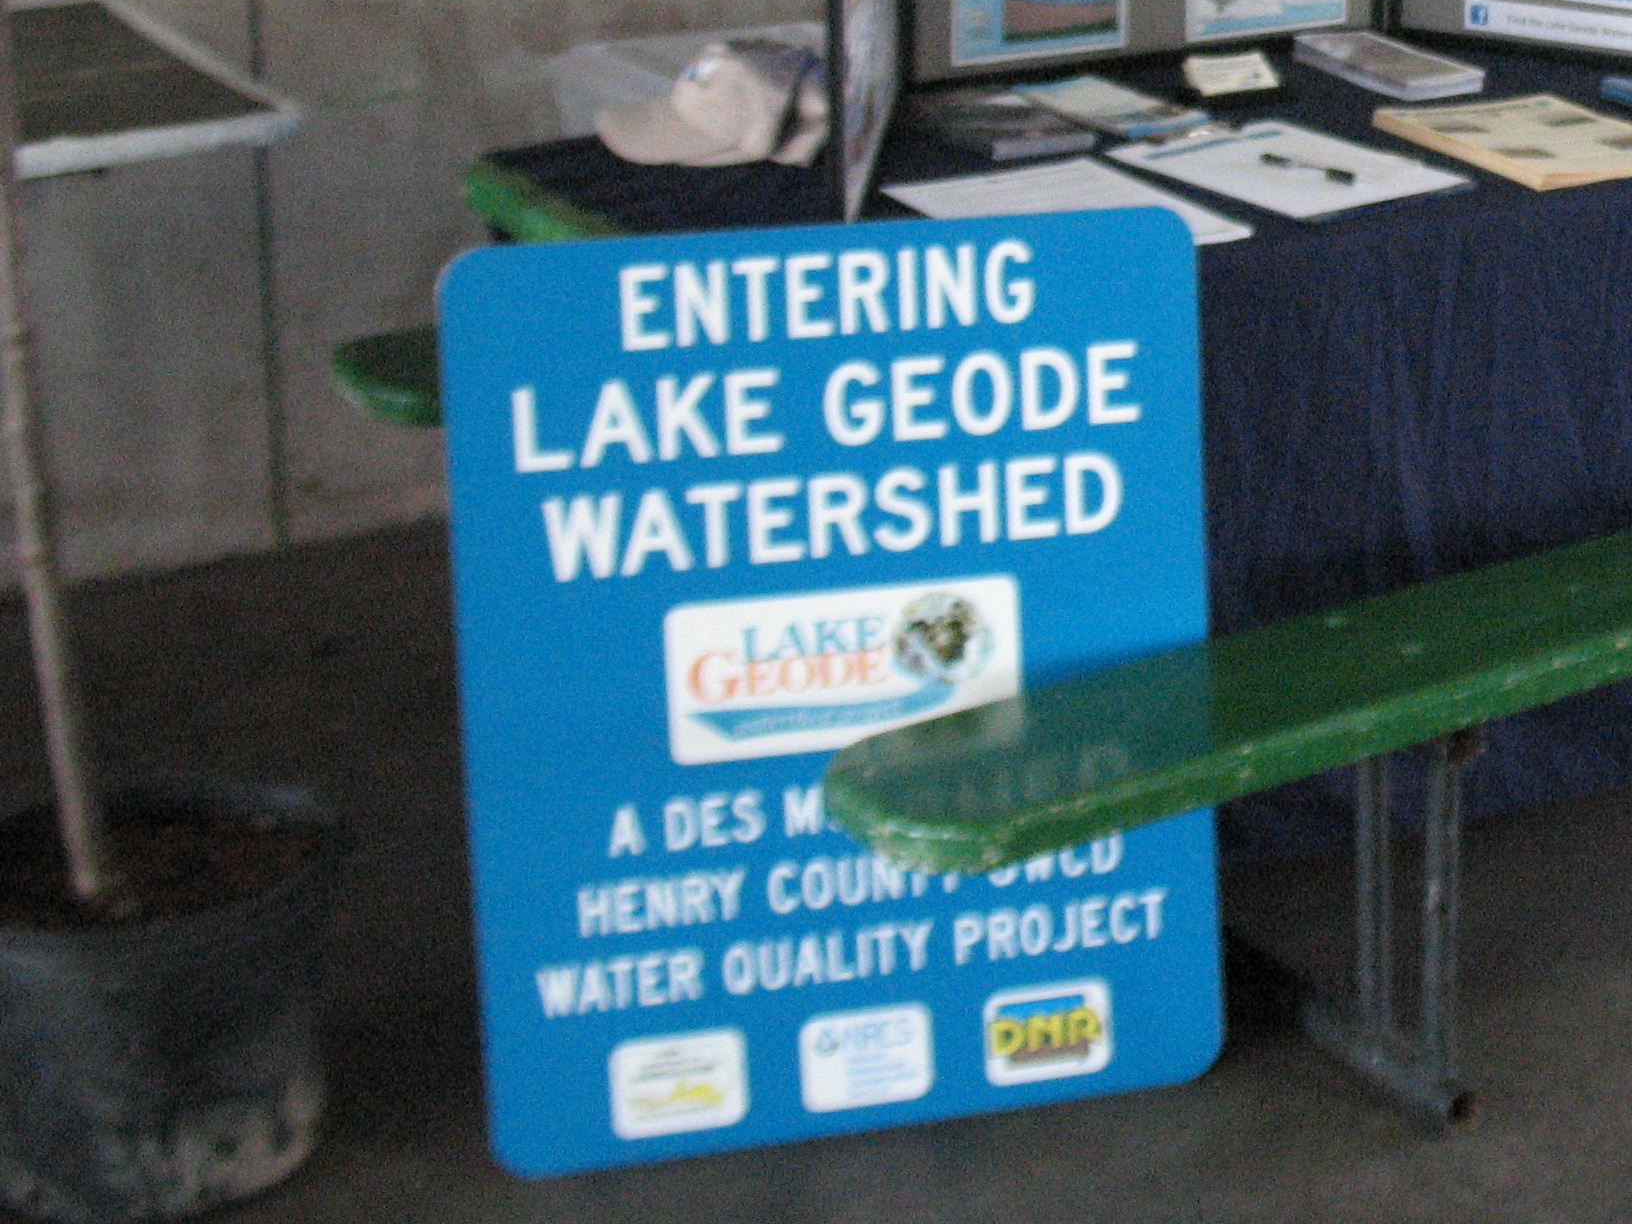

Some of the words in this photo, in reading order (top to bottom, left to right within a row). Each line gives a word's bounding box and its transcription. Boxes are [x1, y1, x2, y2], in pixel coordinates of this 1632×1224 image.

[619, 239, 1036, 352] ENTERING
[510, 367, 785, 474] LAKE
[823, 341, 1141, 447] GEODE
[542, 452, 1124, 583] WATERSHED
[741, 616, 885, 662] LAKE
[686, 648, 890, 704] GEODE
[608, 803, 645, 858] A
[663, 788, 767, 852] DES
[576, 866, 747, 939] HENRY
[535, 945, 705, 1016] WATER
[722, 918, 934, 995] QUALITY
[953, 886, 1168, 966] PROJECT
[989, 1006, 1102, 1057] DNR
